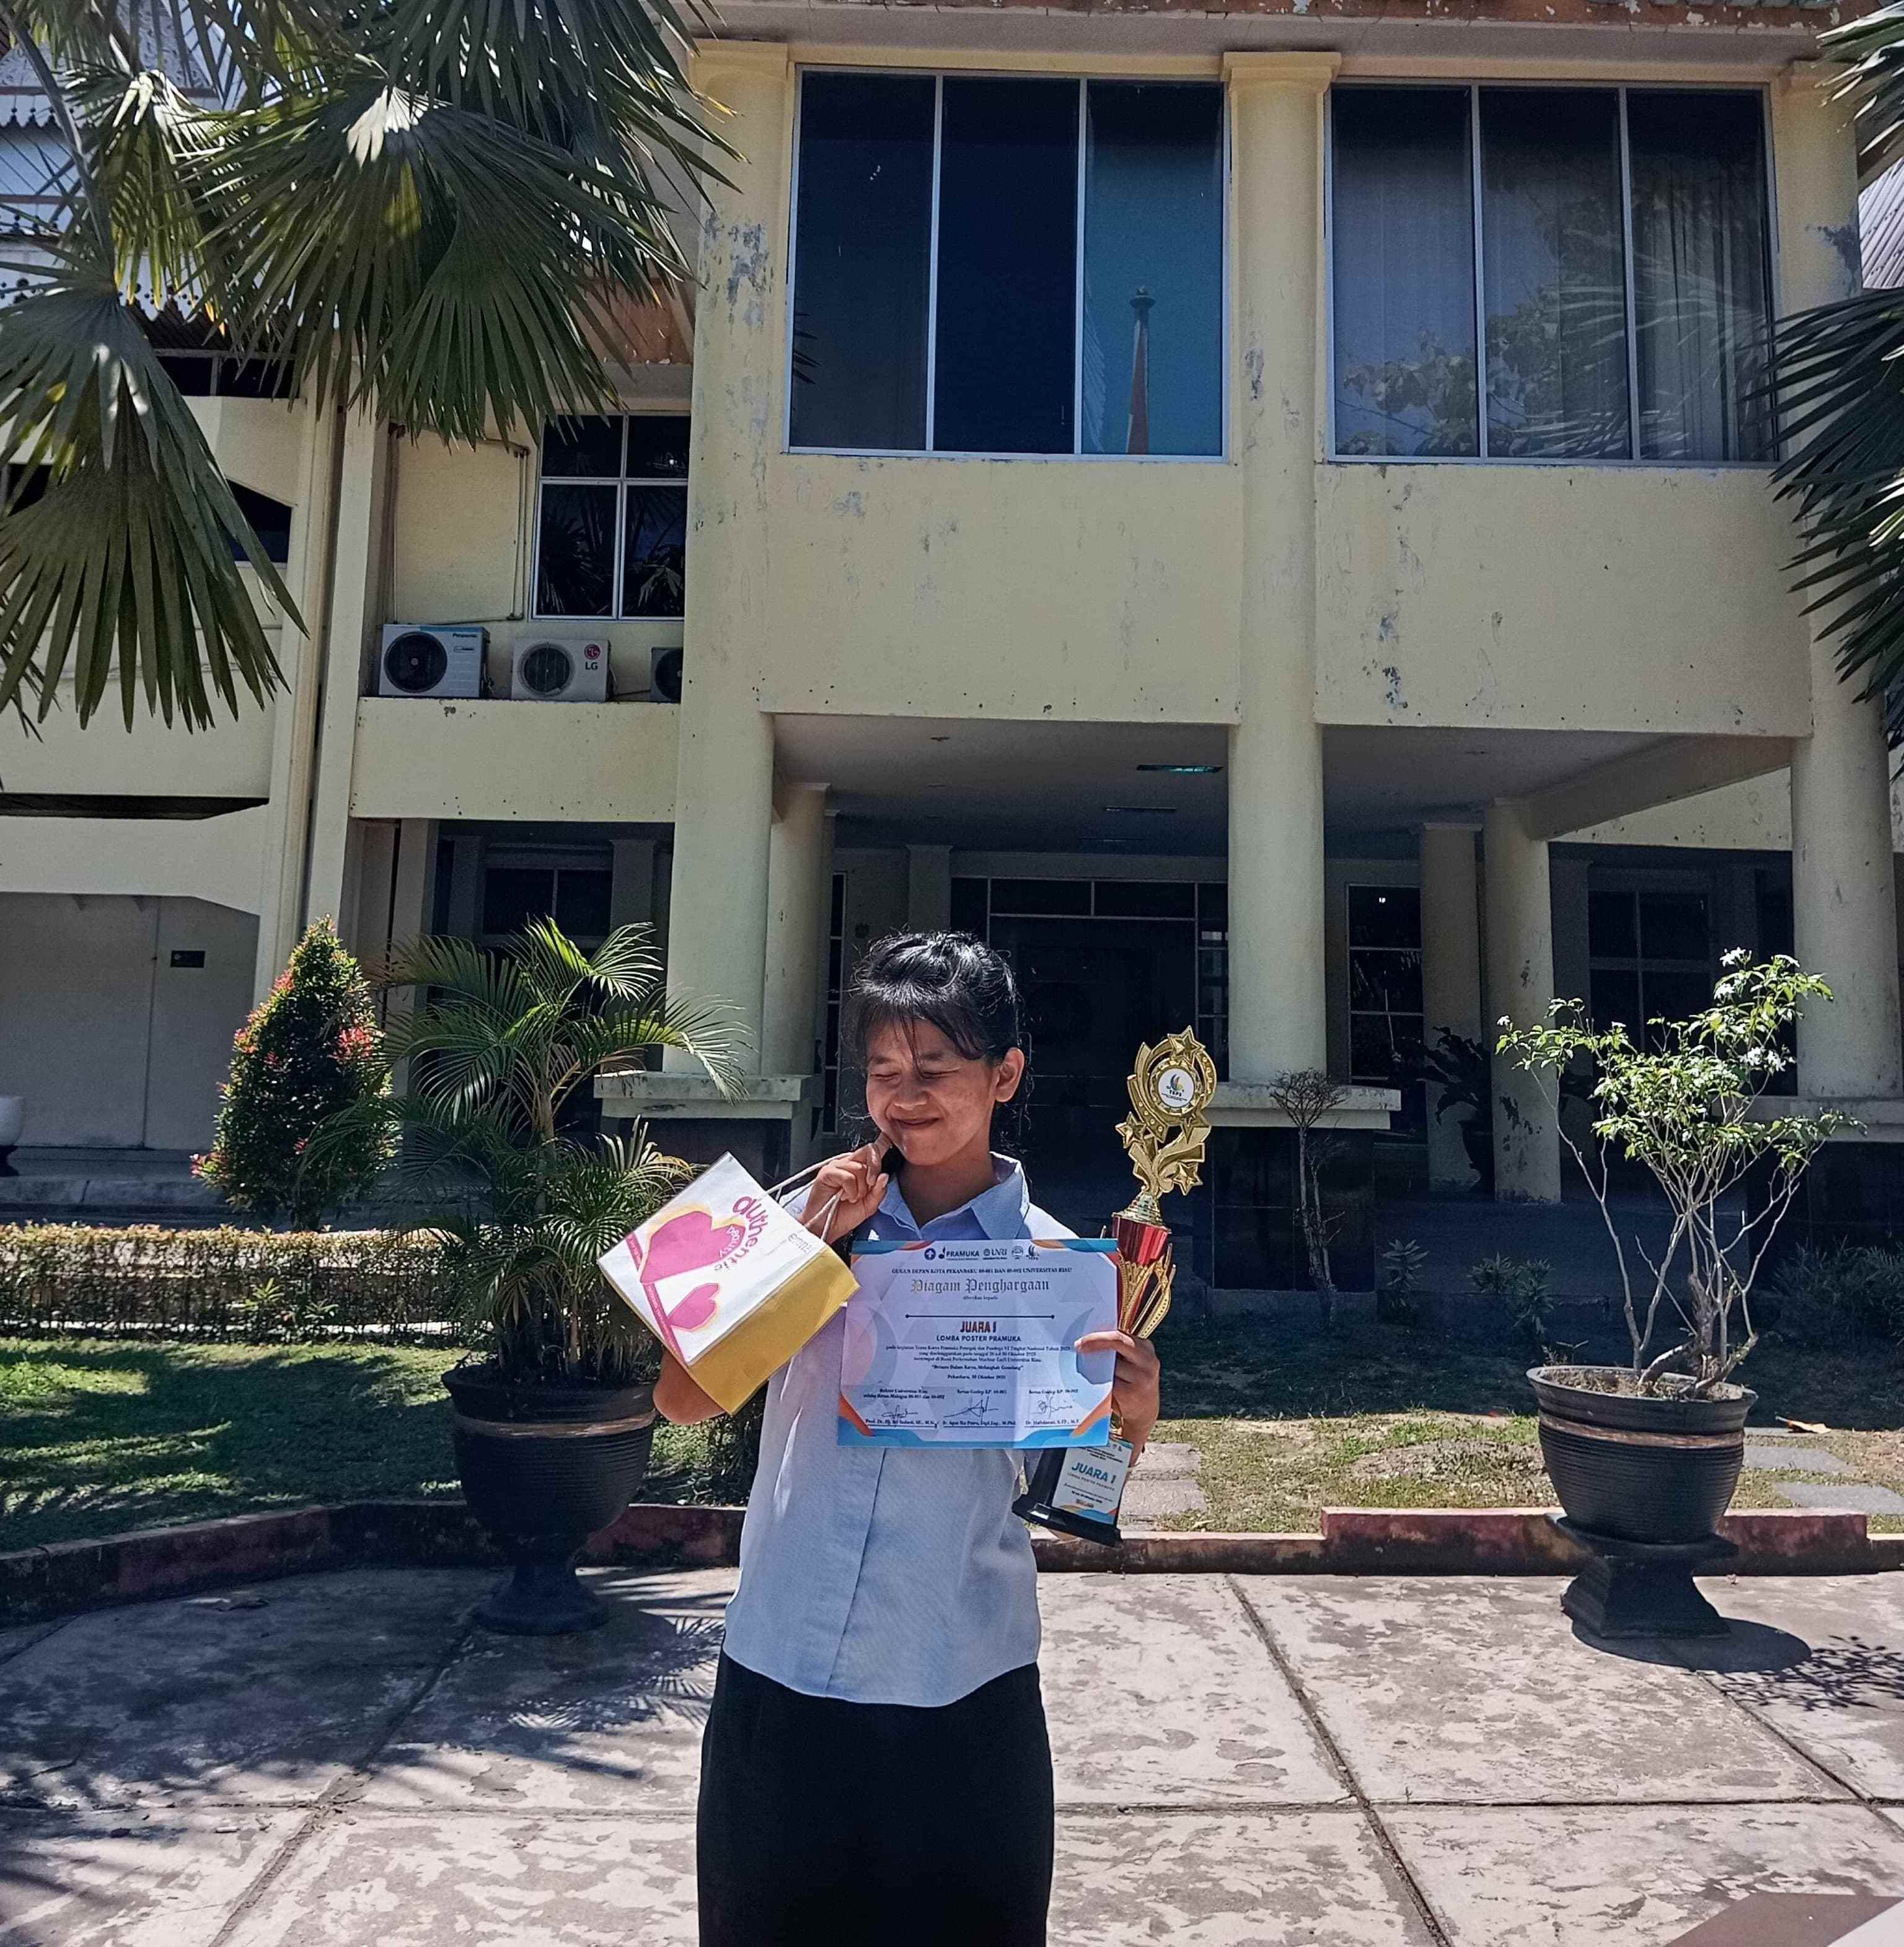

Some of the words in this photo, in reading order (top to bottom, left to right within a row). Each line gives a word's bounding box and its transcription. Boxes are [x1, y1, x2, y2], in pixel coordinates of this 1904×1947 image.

[584, 661, 599, 670] LG
[714, 1196, 769, 1271] authentic
[719, 1224, 741, 1259] beauty
[911, 1278, 961, 1294] Piagam
[965, 1278, 1050, 1294] Penghargaan
[960, 1321, 991, 1333] JUARA
[1072, 1462, 1108, 1482] JUARA
